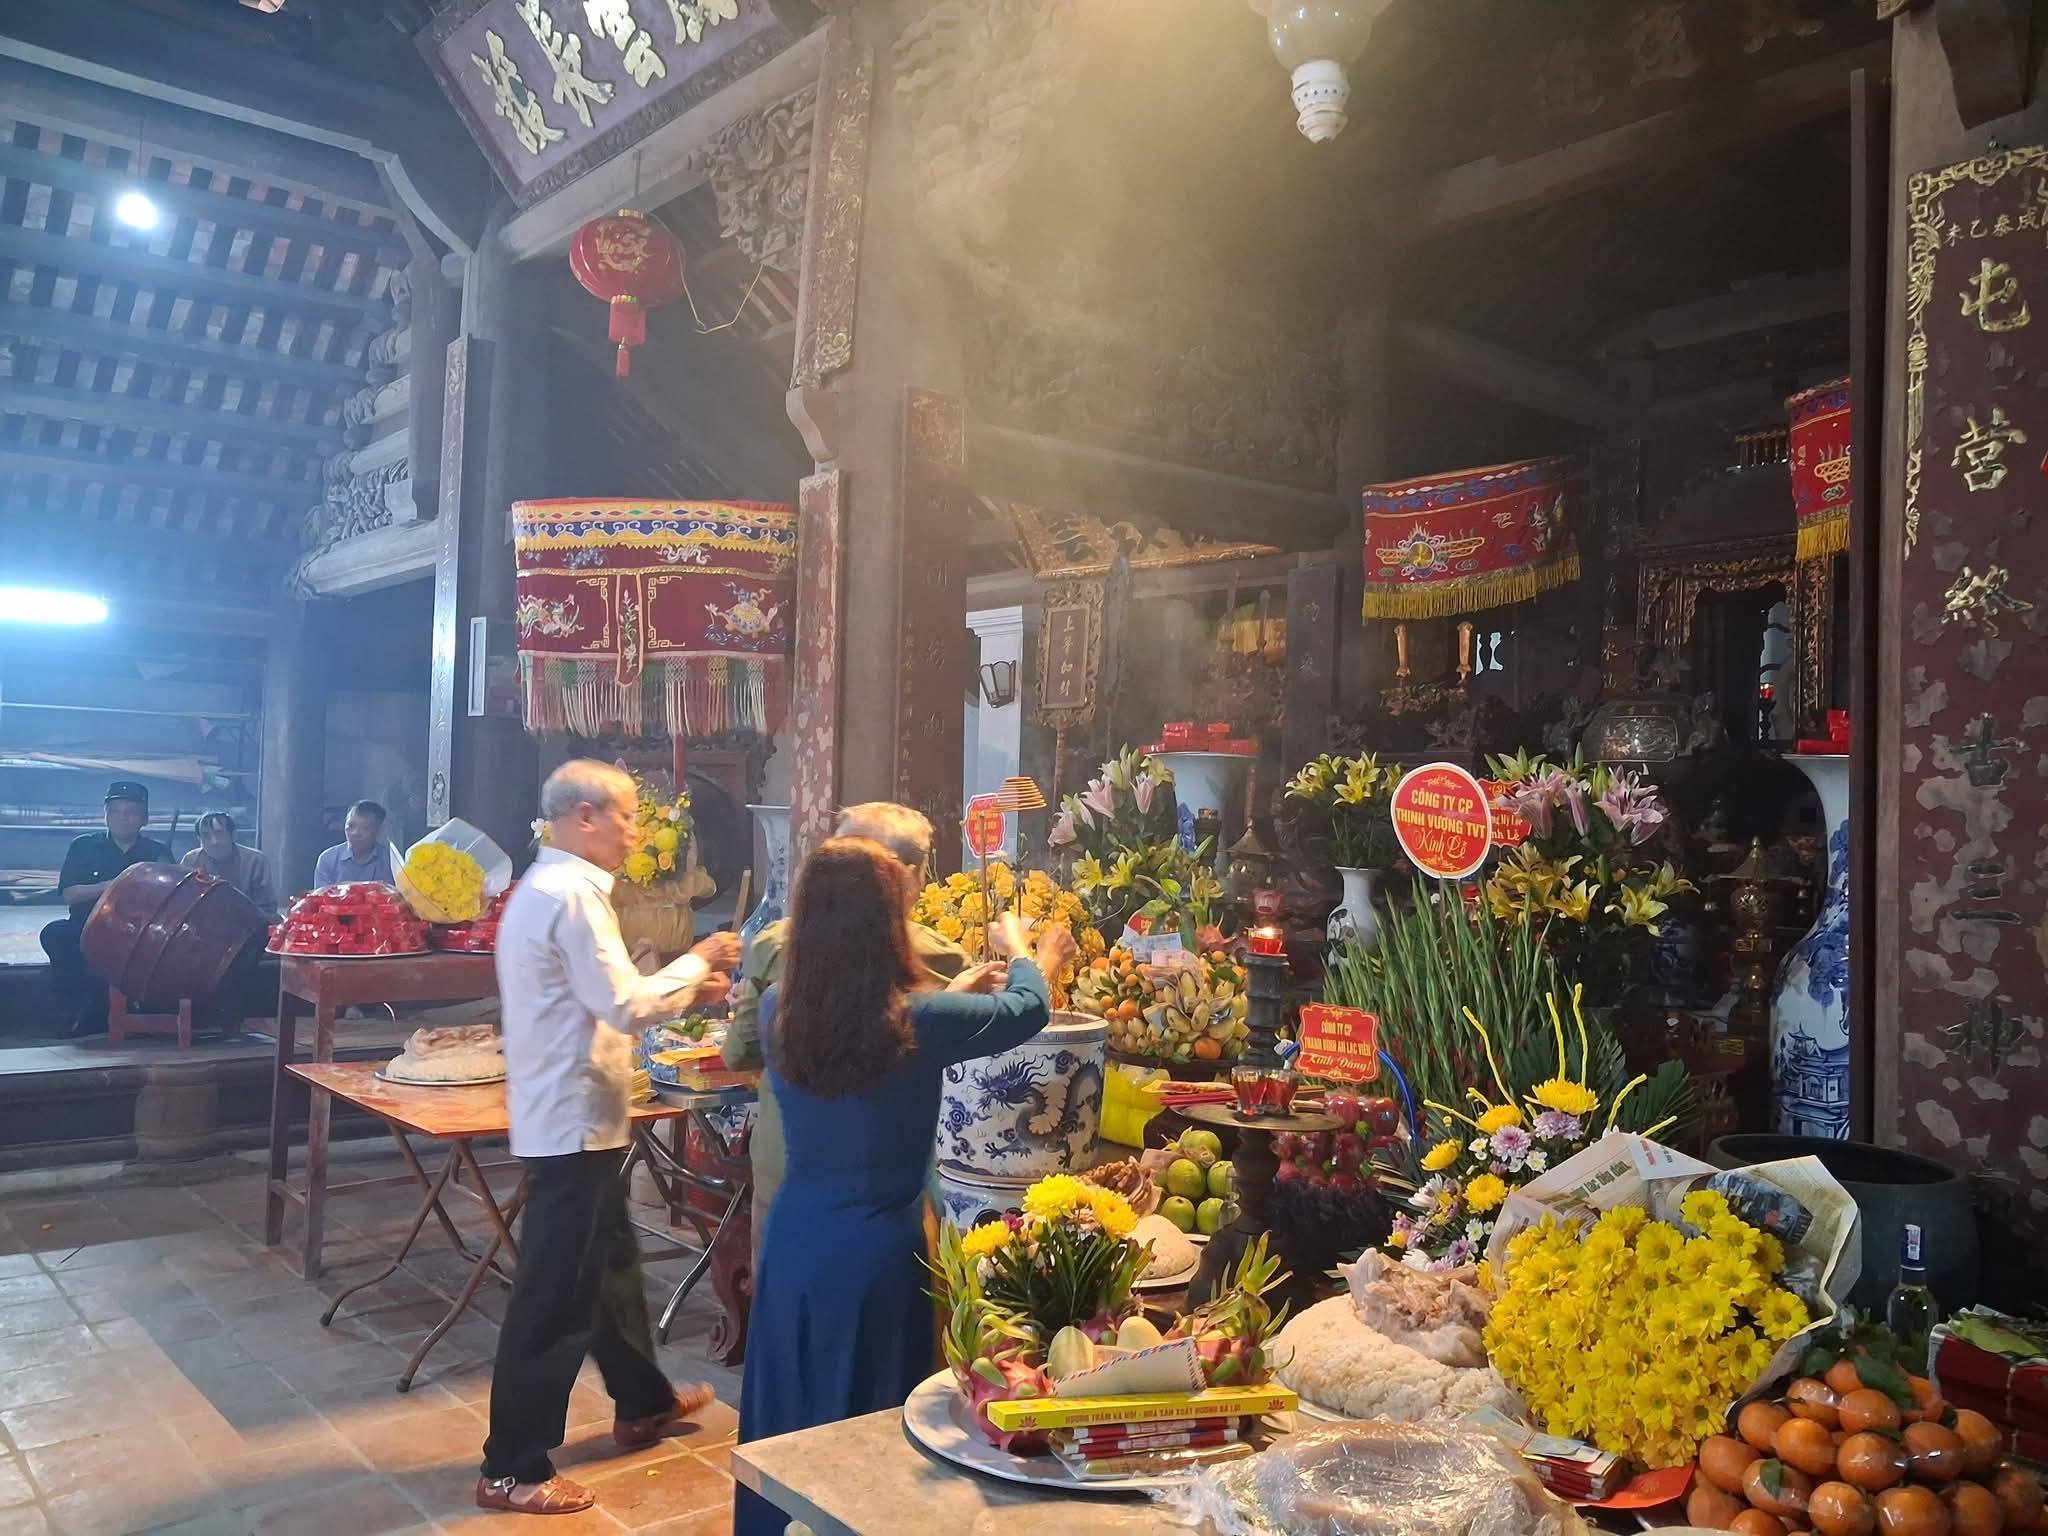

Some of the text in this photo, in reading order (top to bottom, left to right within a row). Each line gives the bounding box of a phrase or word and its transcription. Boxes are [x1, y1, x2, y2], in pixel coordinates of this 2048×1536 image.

[1411, 787, 1440, 809] CÔNG
[1442, 795, 1456, 811] TY
[1458, 797, 1474, 814] CP
[1396, 807, 1486, 839] THỊNH VƯỢNG TVT
